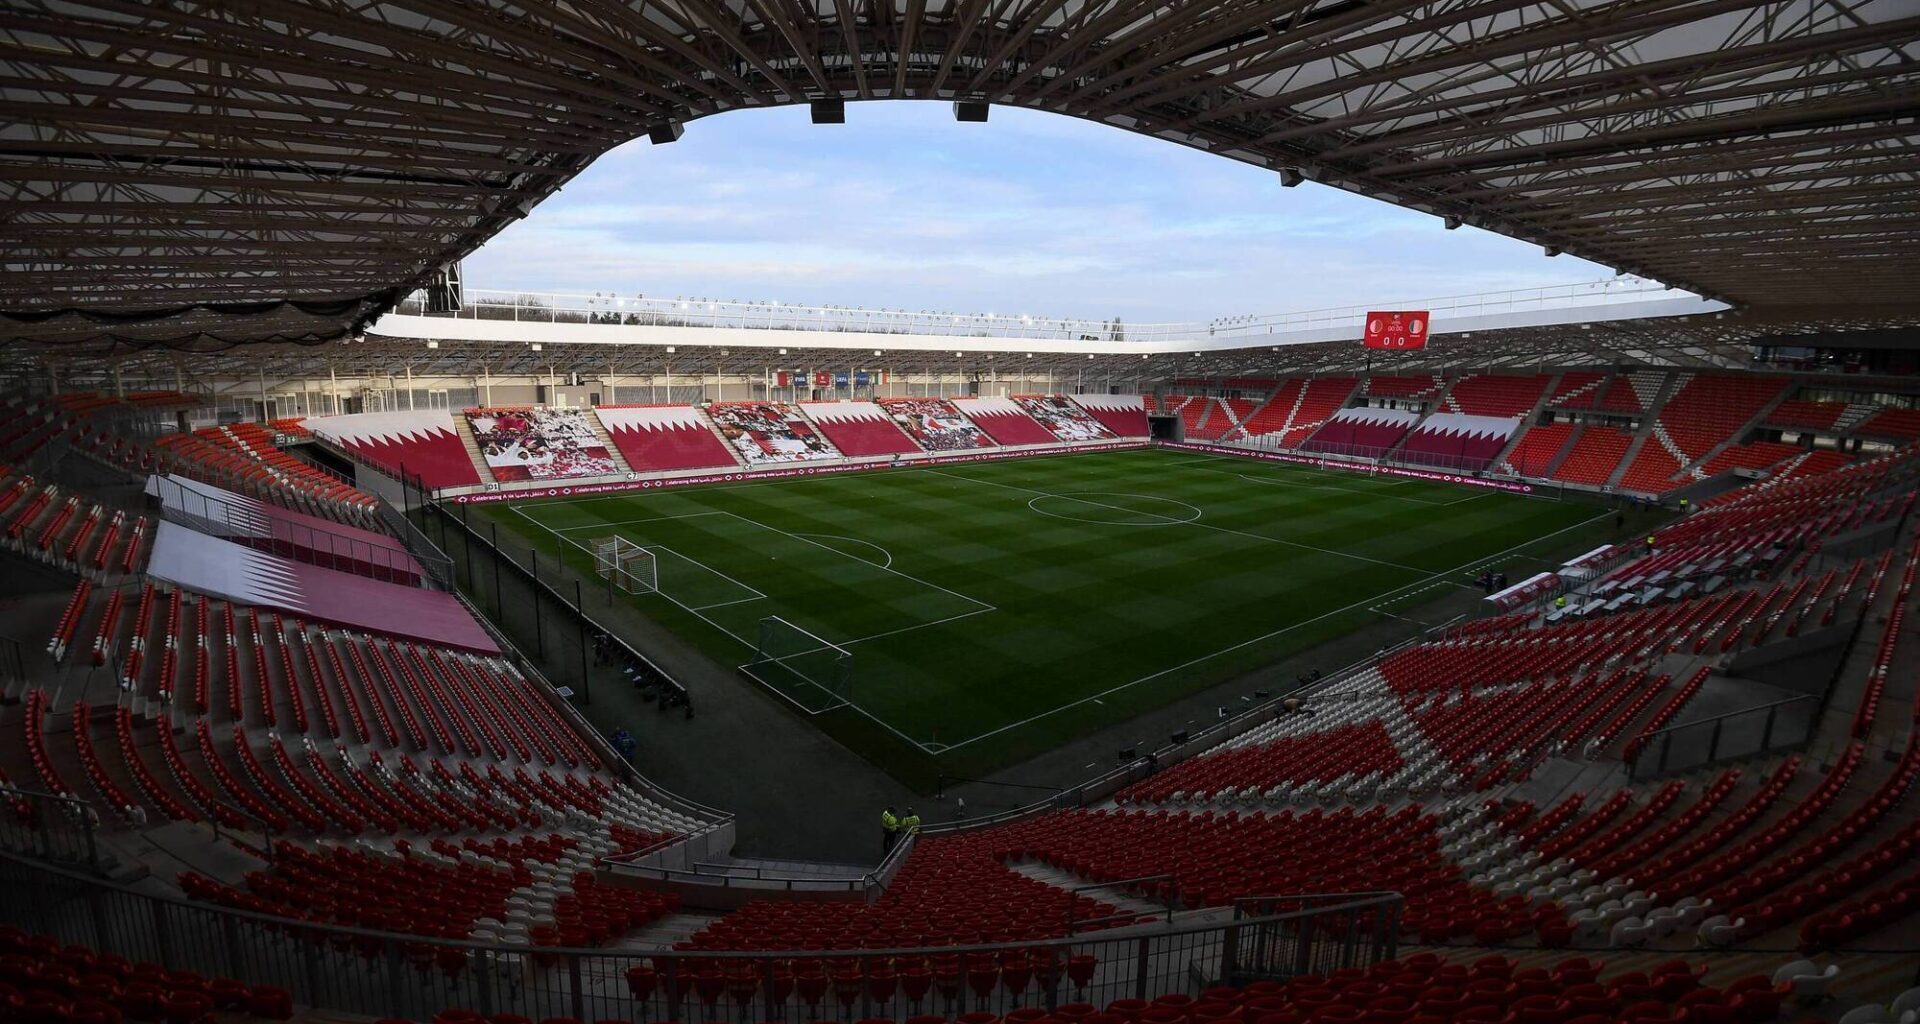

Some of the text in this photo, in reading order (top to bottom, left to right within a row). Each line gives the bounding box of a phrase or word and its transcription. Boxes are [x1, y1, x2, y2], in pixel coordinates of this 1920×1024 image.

[1384, 337, 1404, 345] 0 0
[472, 494, 502, 502] Celebrating
